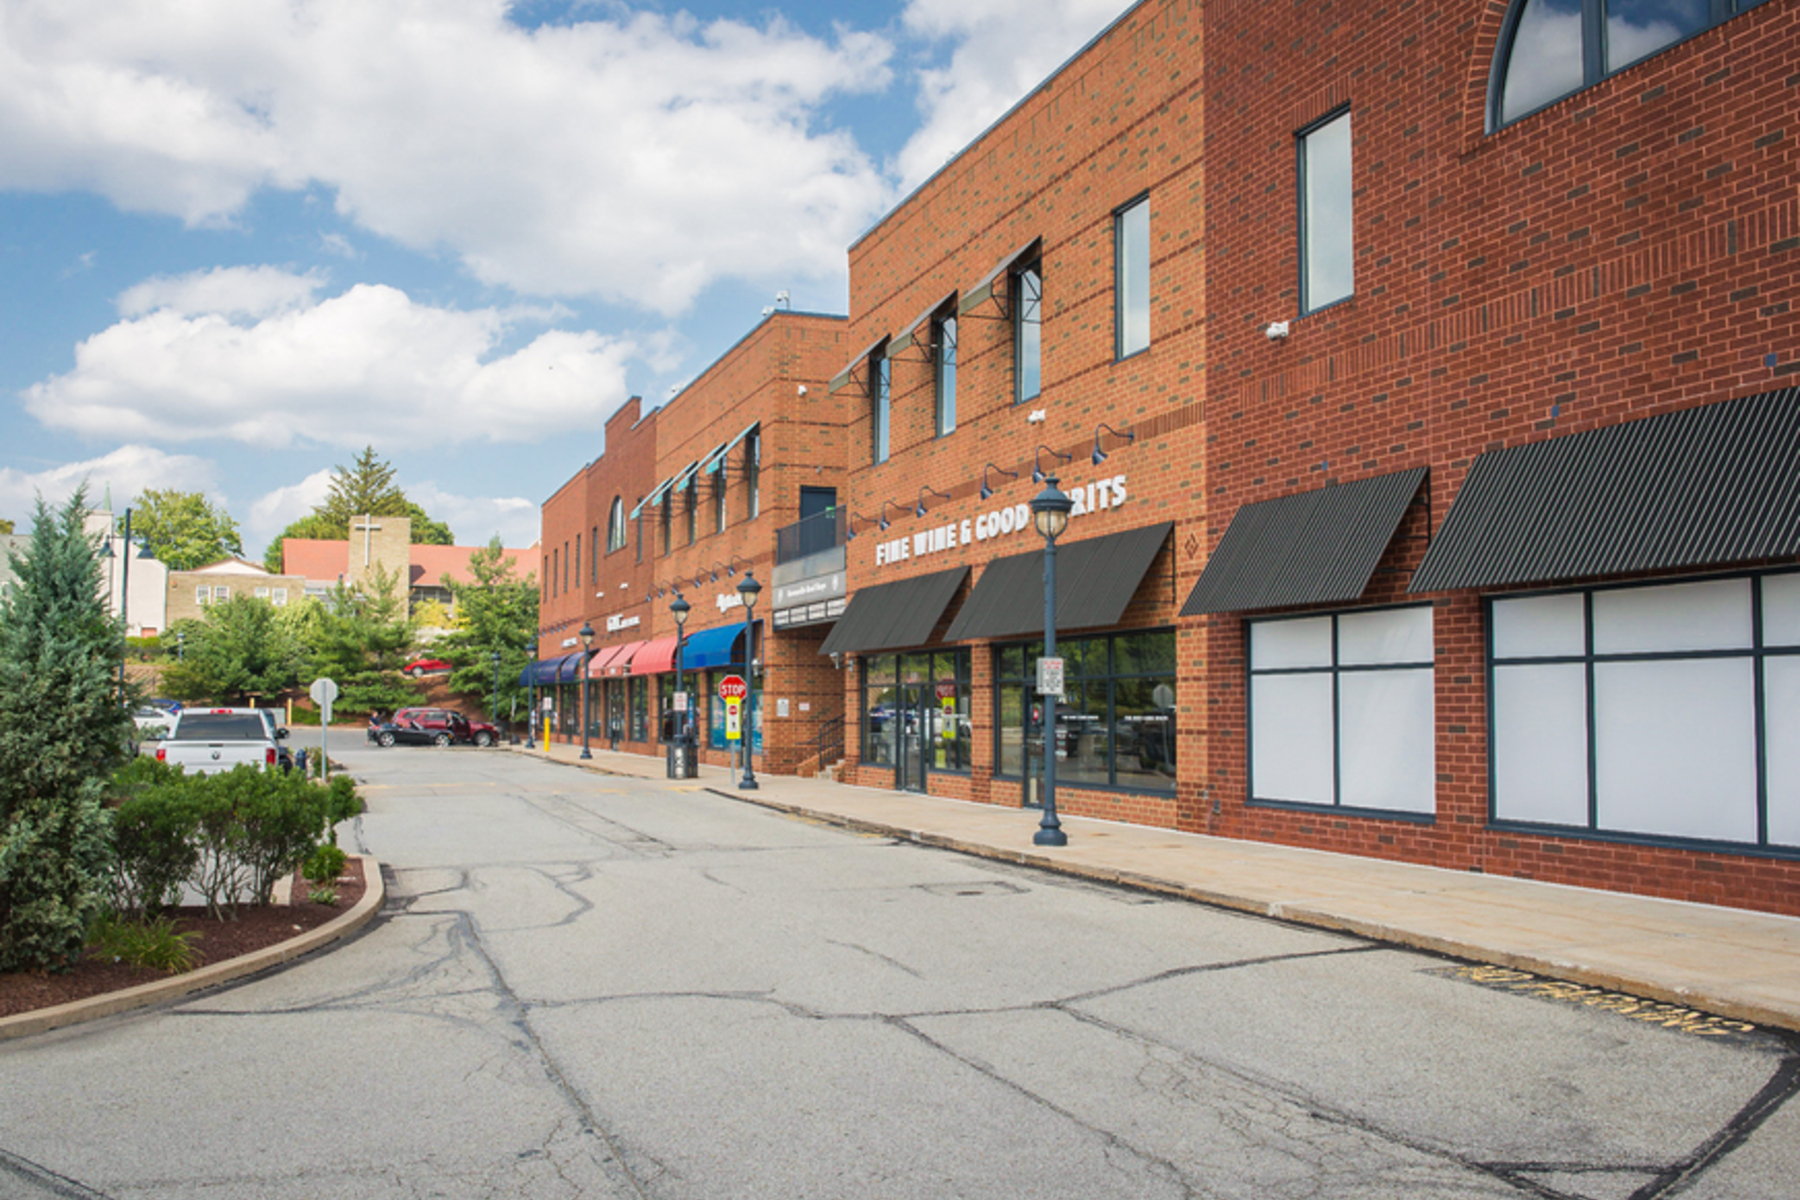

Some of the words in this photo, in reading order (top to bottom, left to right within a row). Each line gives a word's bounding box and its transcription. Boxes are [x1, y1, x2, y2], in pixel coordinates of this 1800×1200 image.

[876, 536, 909, 567] FINE
[914, 523, 957, 557] WINE
[960, 519, 972, 546] &
[975, 503, 1029, 541] GOOD
[1063, 474, 1127, 518] RITS
[720, 684, 746, 697] STOP
